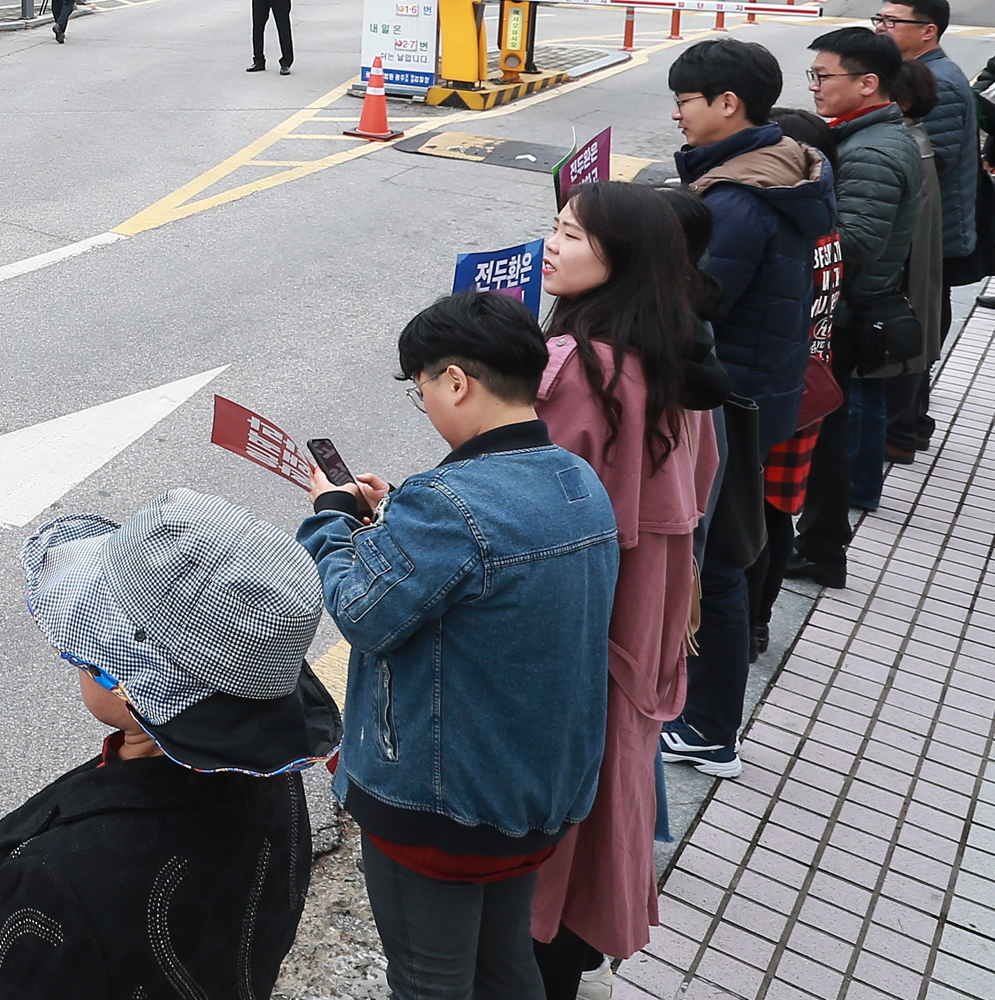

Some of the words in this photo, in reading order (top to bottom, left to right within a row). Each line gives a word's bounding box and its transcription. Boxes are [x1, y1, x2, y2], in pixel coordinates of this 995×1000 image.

[423, 5, 433, 16] 번
[369, 23, 402, 35] 내일은
[419, 41, 429, 52] 번
[380, 52, 395, 62] 쉬는
[397, 53, 430, 64] 날입니다.
[570, 141, 599, 183] 전두환은
[474, 252, 533, 293] 전두환은
